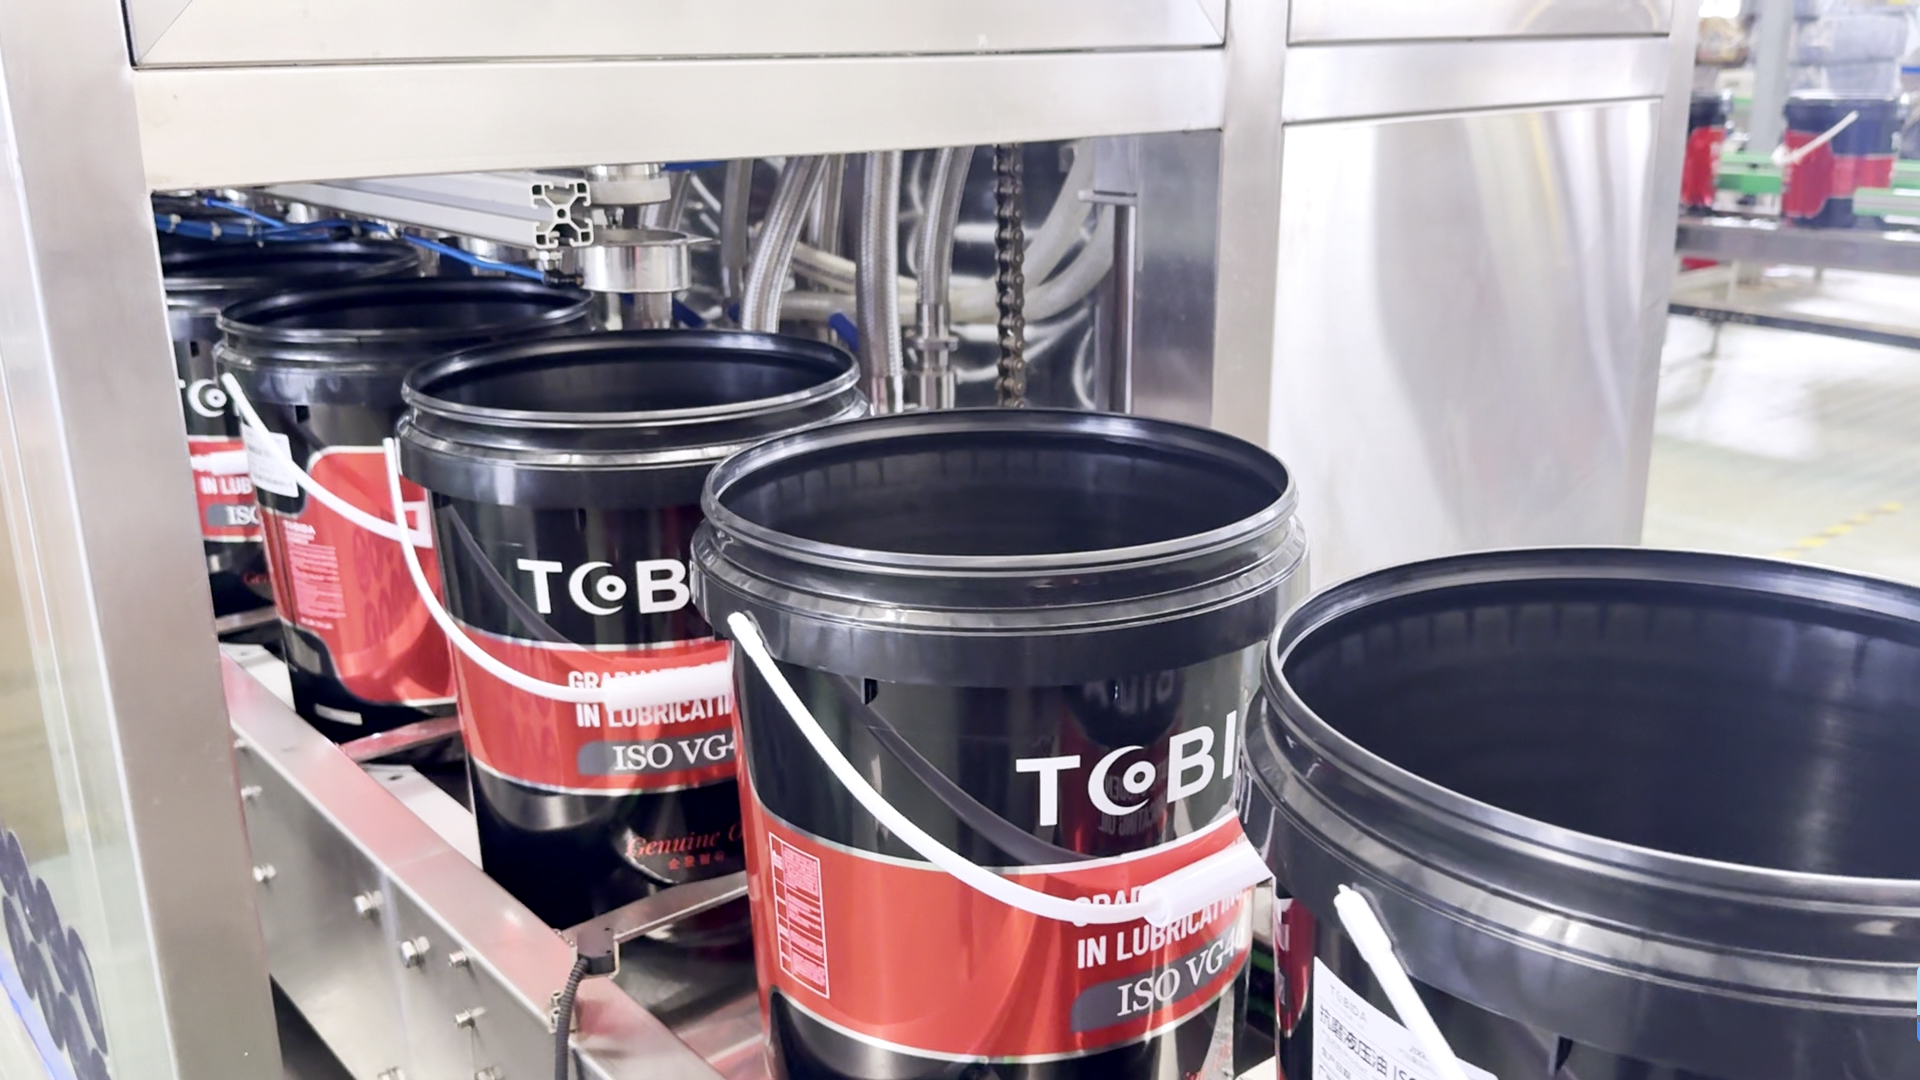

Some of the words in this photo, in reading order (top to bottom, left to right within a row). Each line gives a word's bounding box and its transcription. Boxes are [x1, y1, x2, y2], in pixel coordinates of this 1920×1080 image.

[200, 476, 218, 495] IN
[576, 703, 601, 727] IN
[613, 743, 673, 772] ISO
[626, 830, 720, 858] Genuine
[1077, 931, 1107, 969] IN
[1116, 968, 1181, 1017] ISO
